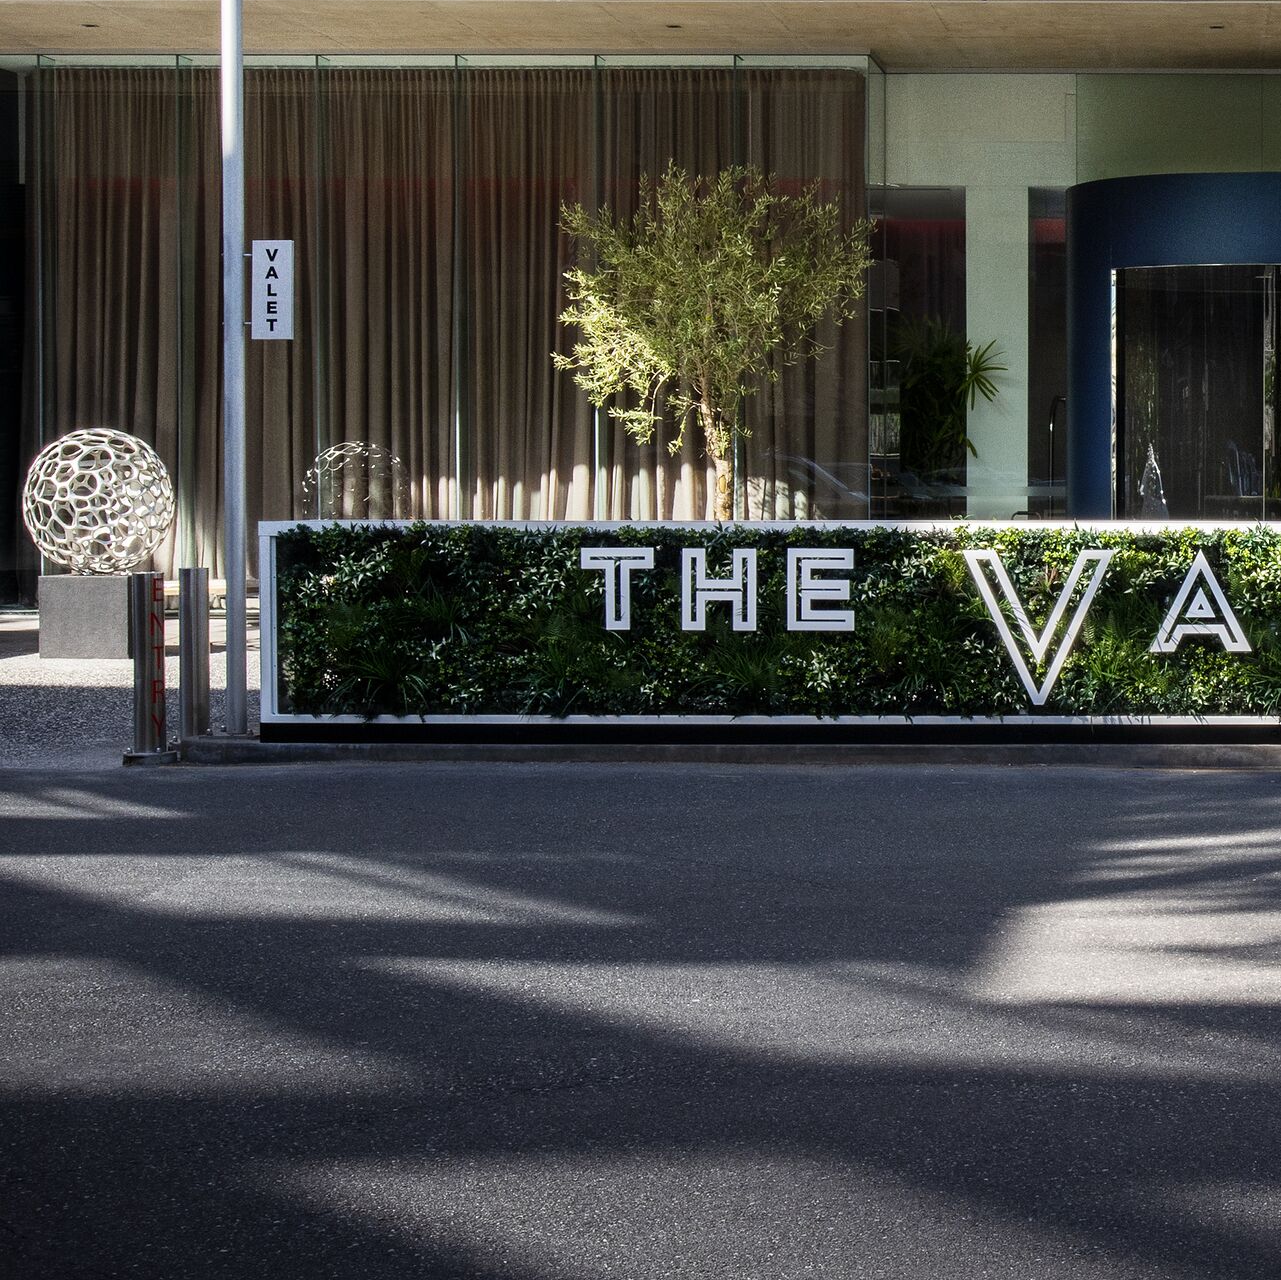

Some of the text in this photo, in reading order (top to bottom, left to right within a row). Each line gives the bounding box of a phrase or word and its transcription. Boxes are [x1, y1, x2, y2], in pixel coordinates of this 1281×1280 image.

[265, 249, 279, 332] VALET
[581, 547, 855, 631] THE
[150, 578, 164, 737] ENTRY
